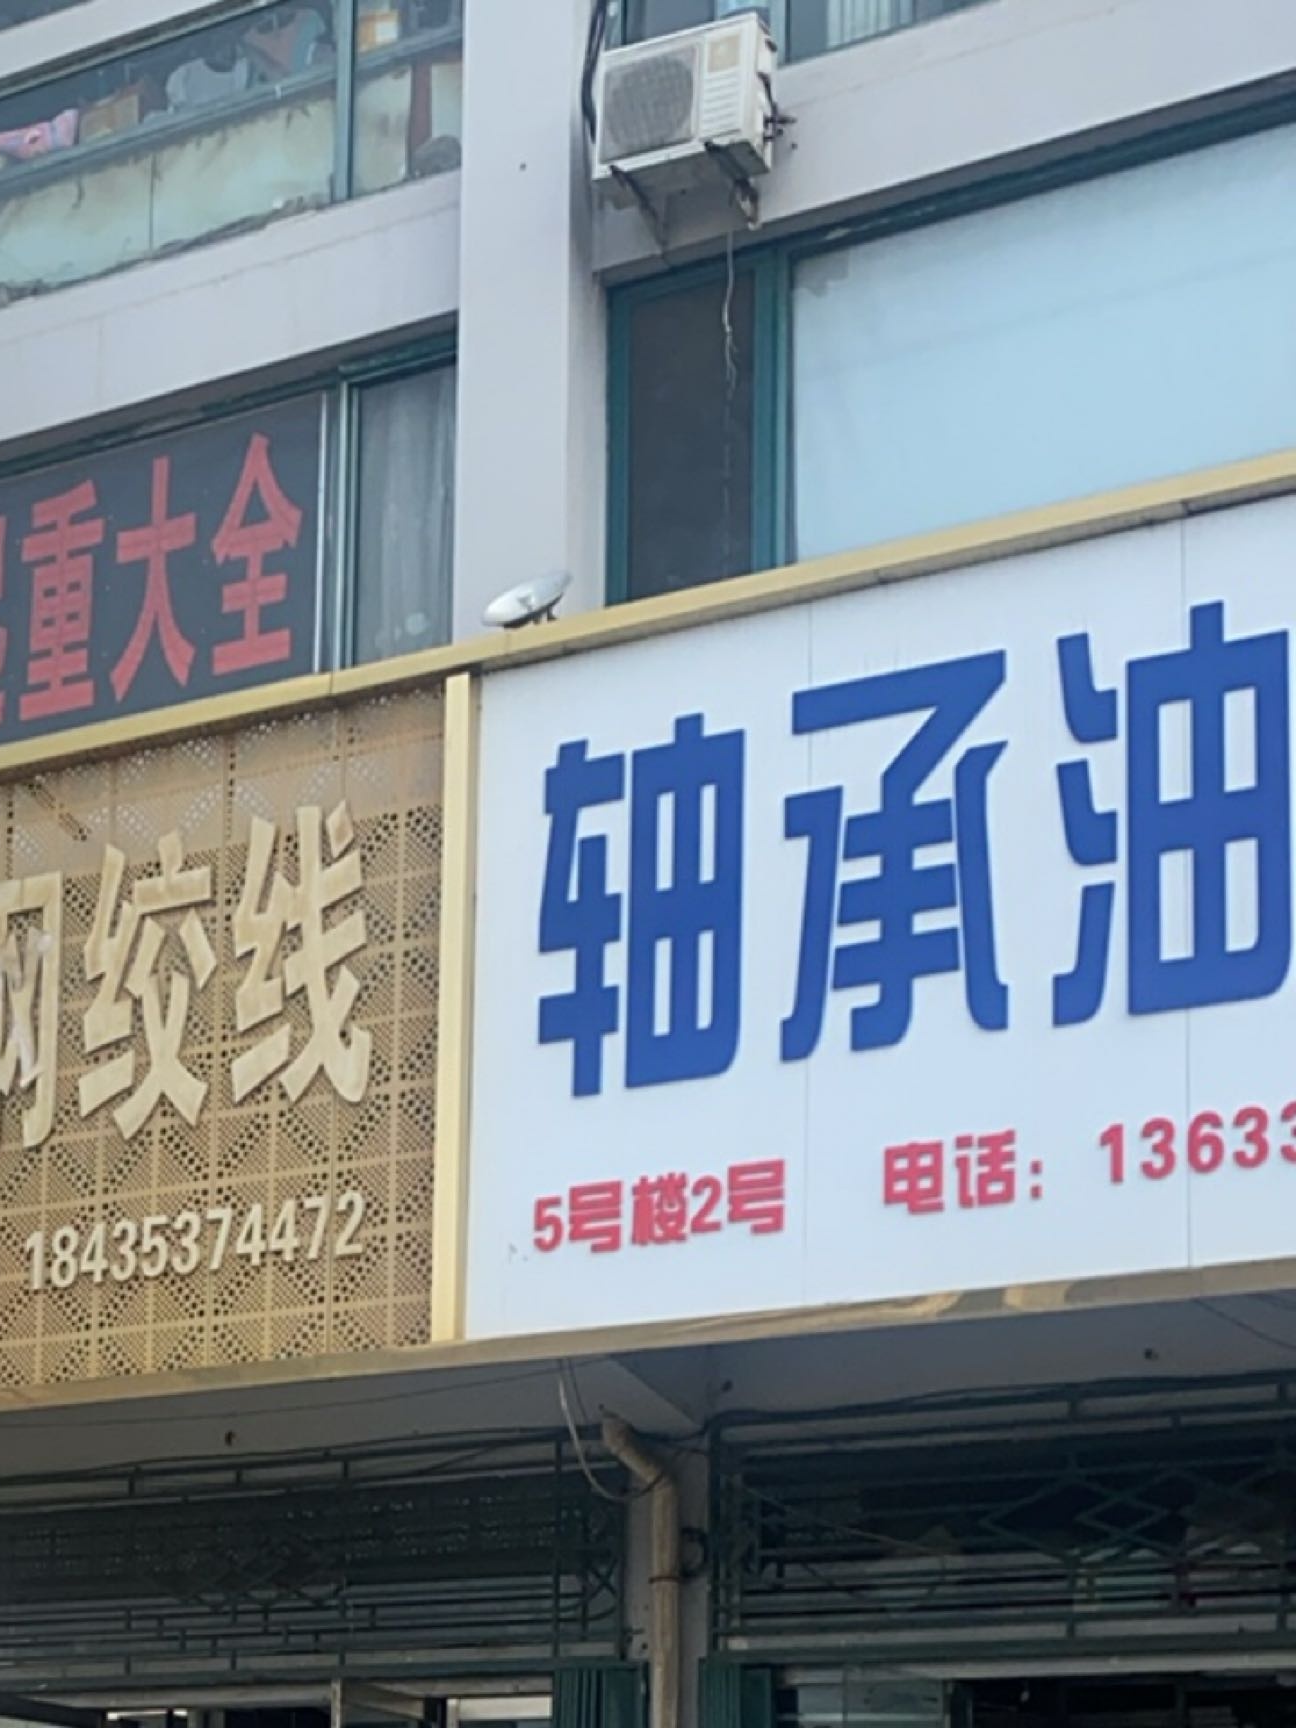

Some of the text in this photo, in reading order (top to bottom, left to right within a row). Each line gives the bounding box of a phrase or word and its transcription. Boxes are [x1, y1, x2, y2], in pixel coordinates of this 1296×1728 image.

[538, 600, 1292, 1098] 轴承油
[23, 1189, 365, 1292] 18435374472
[532, 1158, 787, 1254] 5号楼2号
